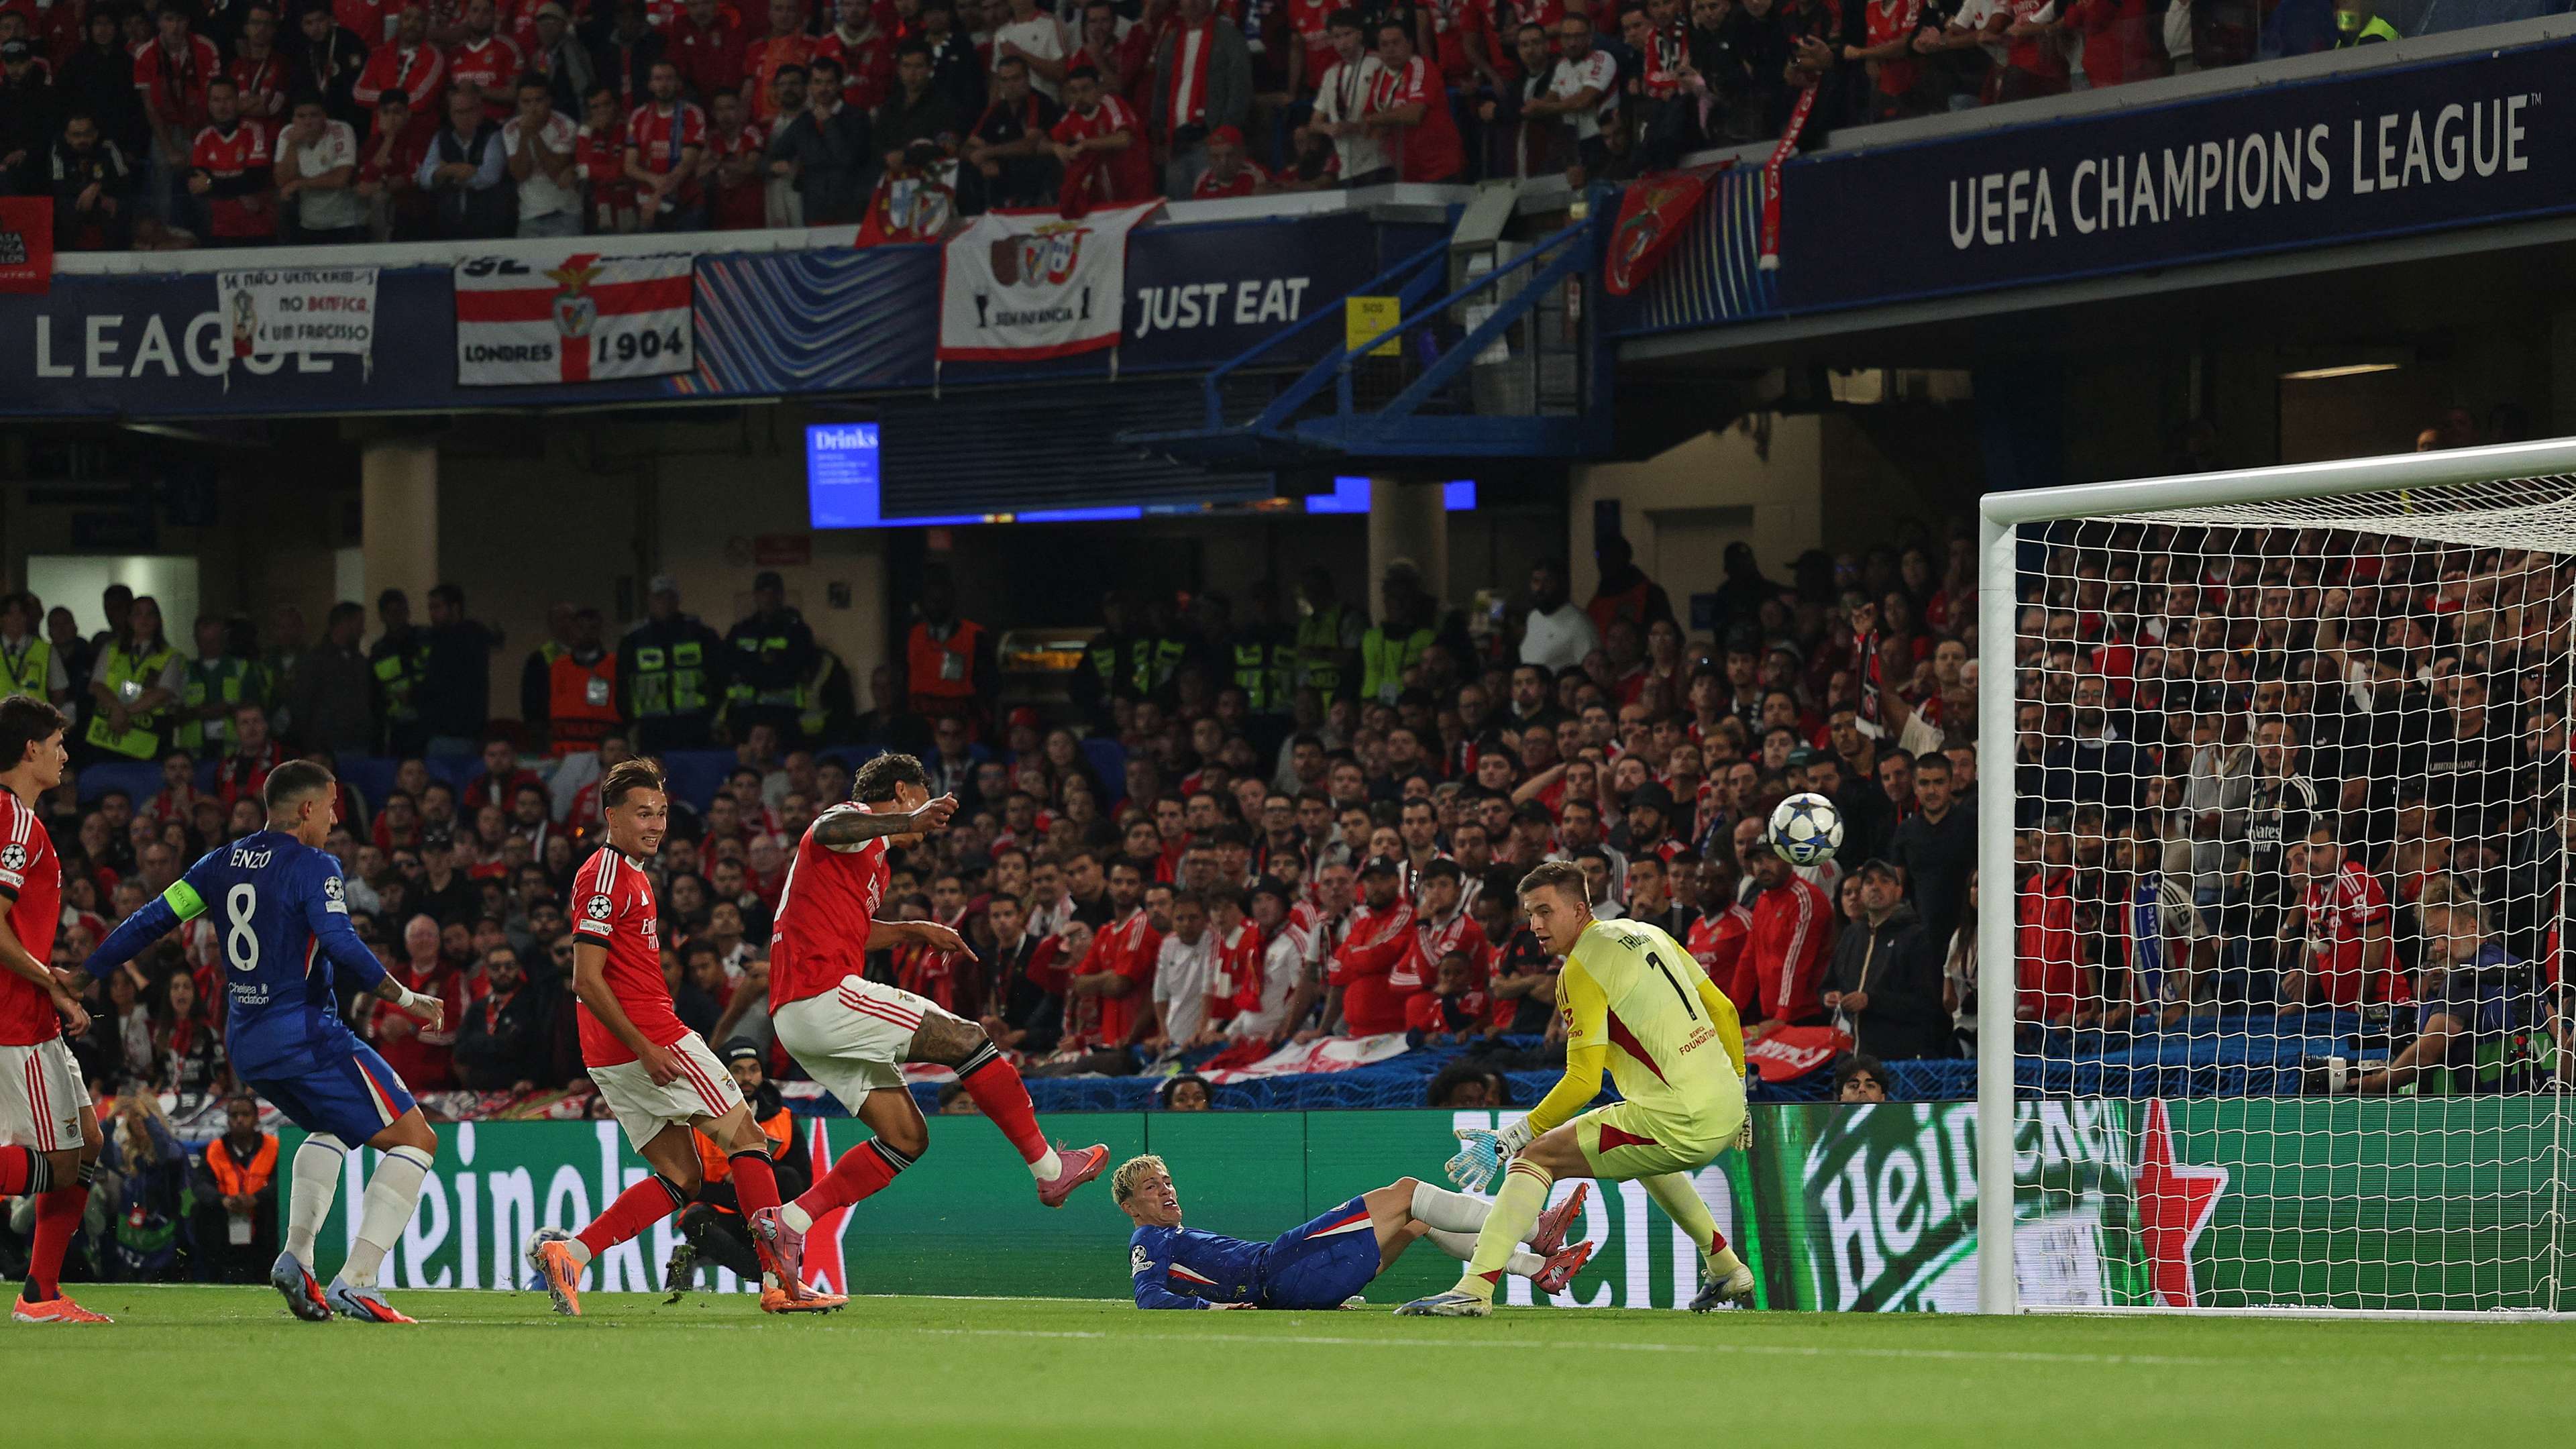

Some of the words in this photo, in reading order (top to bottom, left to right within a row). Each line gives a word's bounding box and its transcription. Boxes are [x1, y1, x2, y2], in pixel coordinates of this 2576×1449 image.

[1948, 166, 2057, 250] UEFA
[2070, 123, 2331, 235] CHAMPIONS
[2352, 93, 2530, 195] LEAGUE
[1136, 282, 1229, 339] JUST
[1233, 277, 1310, 325] EAT
[36, 311, 334, 378] LEAG
[464, 343, 553, 364] LONDRES
[597, 328, 685, 364] 1904
[816, 429, 879, 450] Drinks
[230, 849, 272, 869] ENZO
[227, 883, 259, 971] 8
[228, 981, 257, 994] Chelsea
[1646, 951, 1698, 1021] 1
